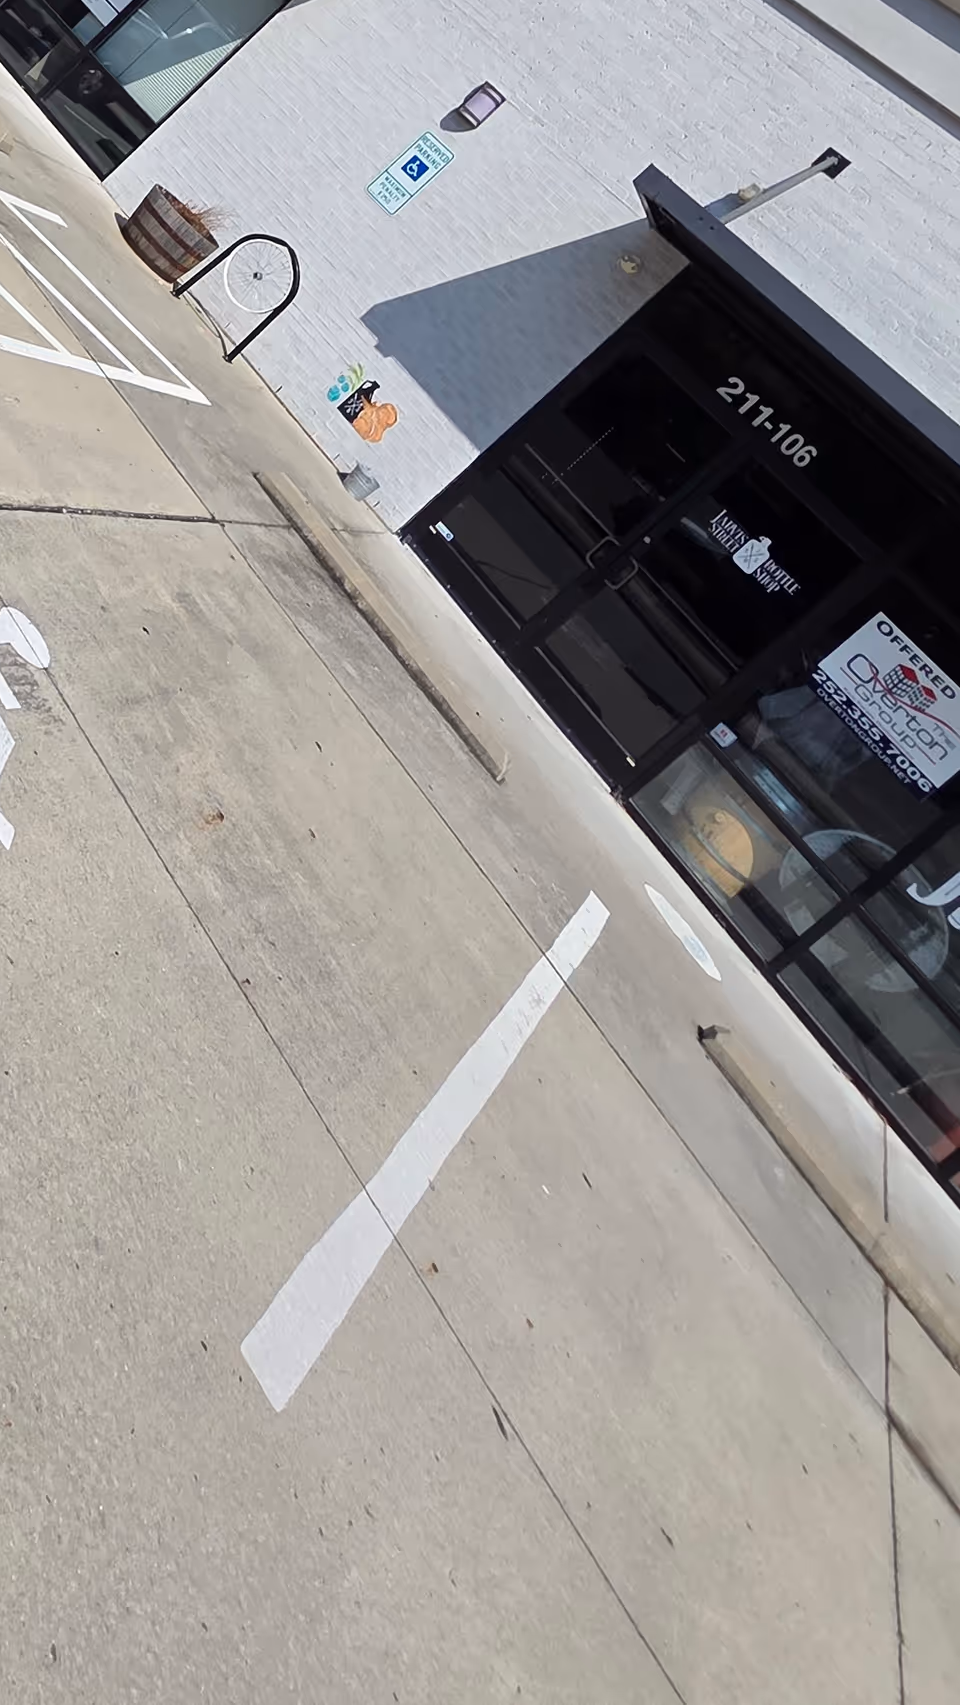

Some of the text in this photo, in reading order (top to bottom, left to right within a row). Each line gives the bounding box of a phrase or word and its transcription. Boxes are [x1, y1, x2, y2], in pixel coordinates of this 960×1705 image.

[414, 143, 441, 170] PARKING
[421, 135, 450, 163] RESERVED
[379, 181, 400, 202] PENALTY
[384, 176, 406, 198] MAXIMUM
[716, 376, 818, 468] 211-106
[708, 522, 741, 553] STREET
[753, 567, 780, 594] SHOP
[763, 559, 802, 596] BOTTLE
[876, 620, 957, 700] OFFERED
[846, 653, 949, 761] Overton
[854, 683, 917, 749] Group
[811, 669, 933, 793] 252.355.7006
[816, 688, 912, 785] OVERTONGROUP.NET
